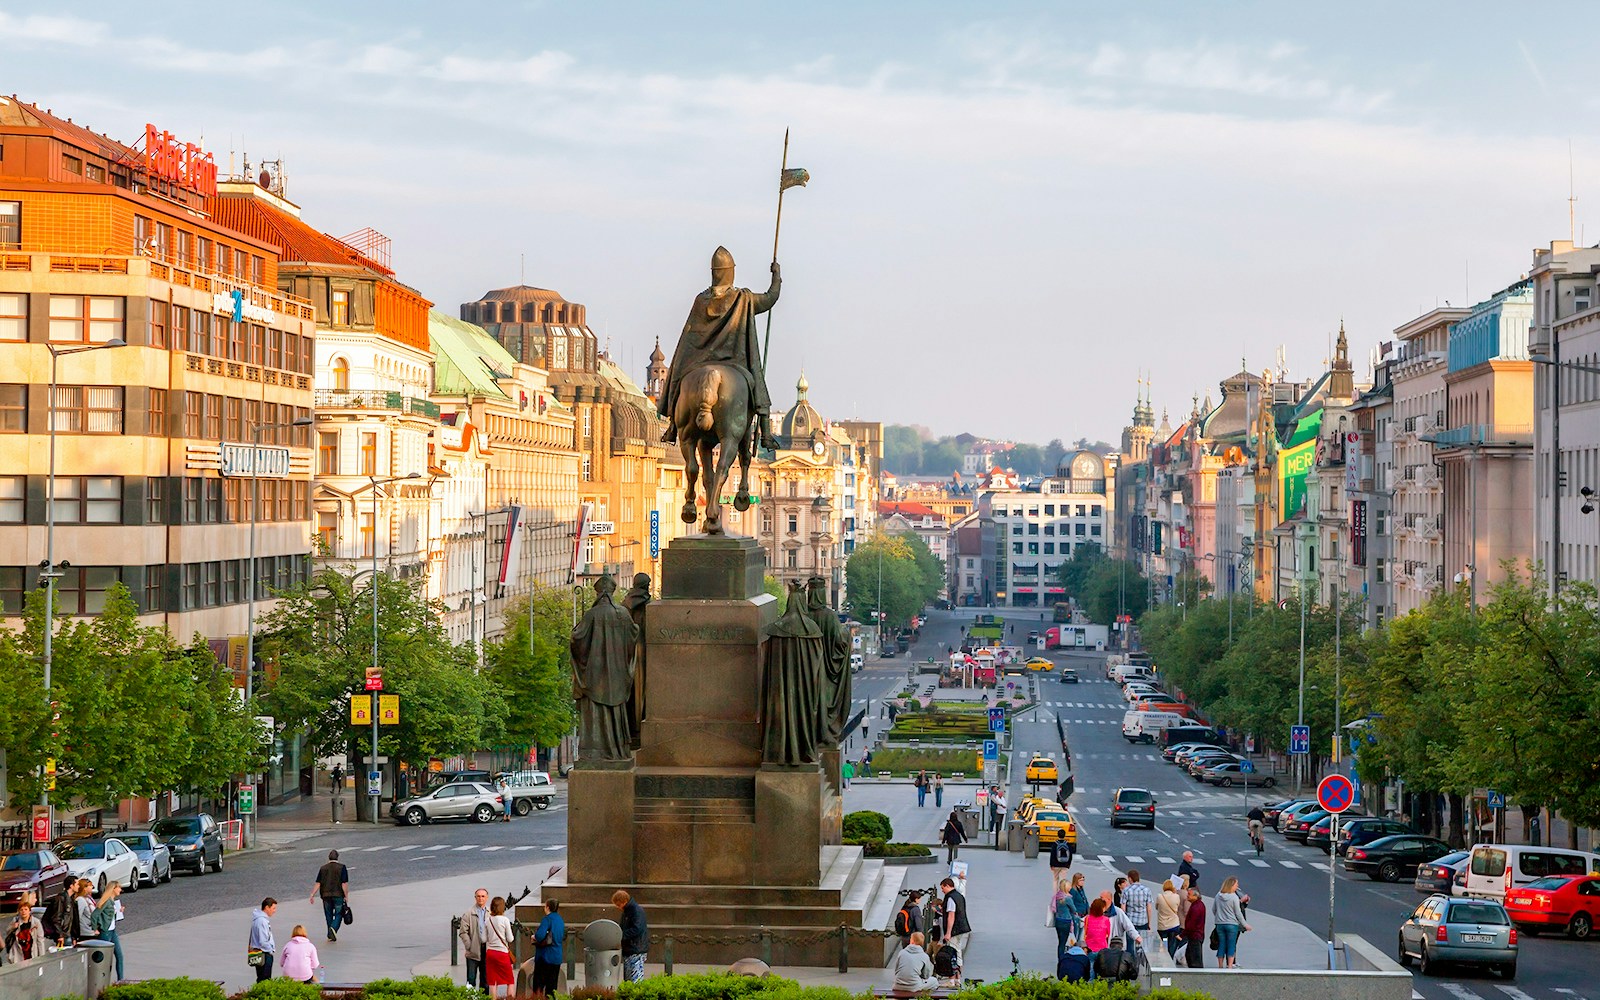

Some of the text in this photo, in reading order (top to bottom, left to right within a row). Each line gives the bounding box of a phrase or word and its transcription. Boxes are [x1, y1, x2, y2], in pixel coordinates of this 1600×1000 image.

[1348, 448, 1357, 497] RAMADA
[997, 720, 1003, 728] P
[986, 742, 995, 754] P
